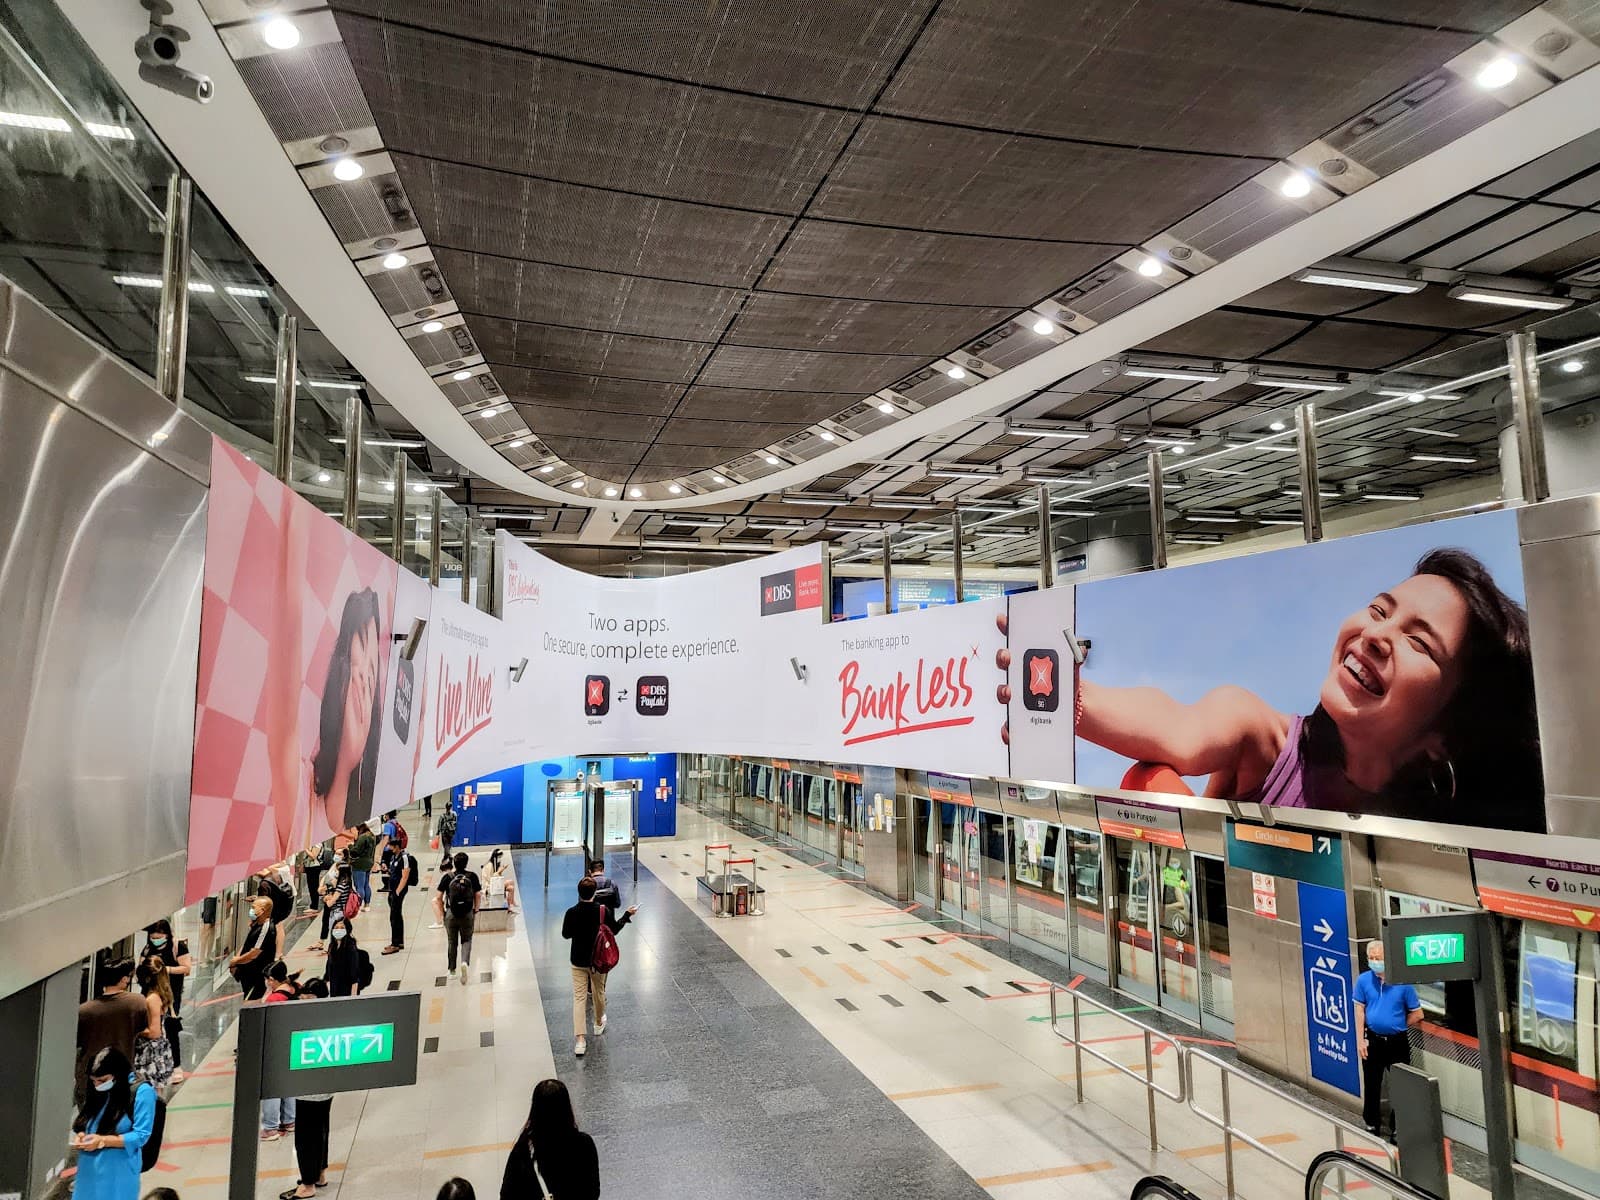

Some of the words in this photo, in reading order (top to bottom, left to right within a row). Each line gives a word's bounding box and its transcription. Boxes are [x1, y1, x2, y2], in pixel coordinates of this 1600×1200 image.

[773, 583, 792, 602] DBS
[588, 612, 617, 632] Two
[623, 617, 670, 637] apps.
[543, 631, 557, 653] One
[558, 637, 588, 659] secure,
[591, 641, 668, 664] complete
[672, 637, 740, 662] experience.
[842, 639, 855, 651] The
[855, 636, 884, 651] banking
[885, 635, 900, 649] app
[901, 633, 910, 646] to
[650, 685, 667, 695] DBS
[838, 660, 911, 735] Bank
[436, 653, 464, 751] Live
[464, 653, 492, 729] More
[1255, 830, 1274, 842] Circle
[1545, 859, 1569, 870] North
[1571, 862, 1588, 872] East
[1564, 881, 1577, 893] to
[1427, 937, 1458, 960] EXIT
[300, 1033, 356, 1064] EXIT
